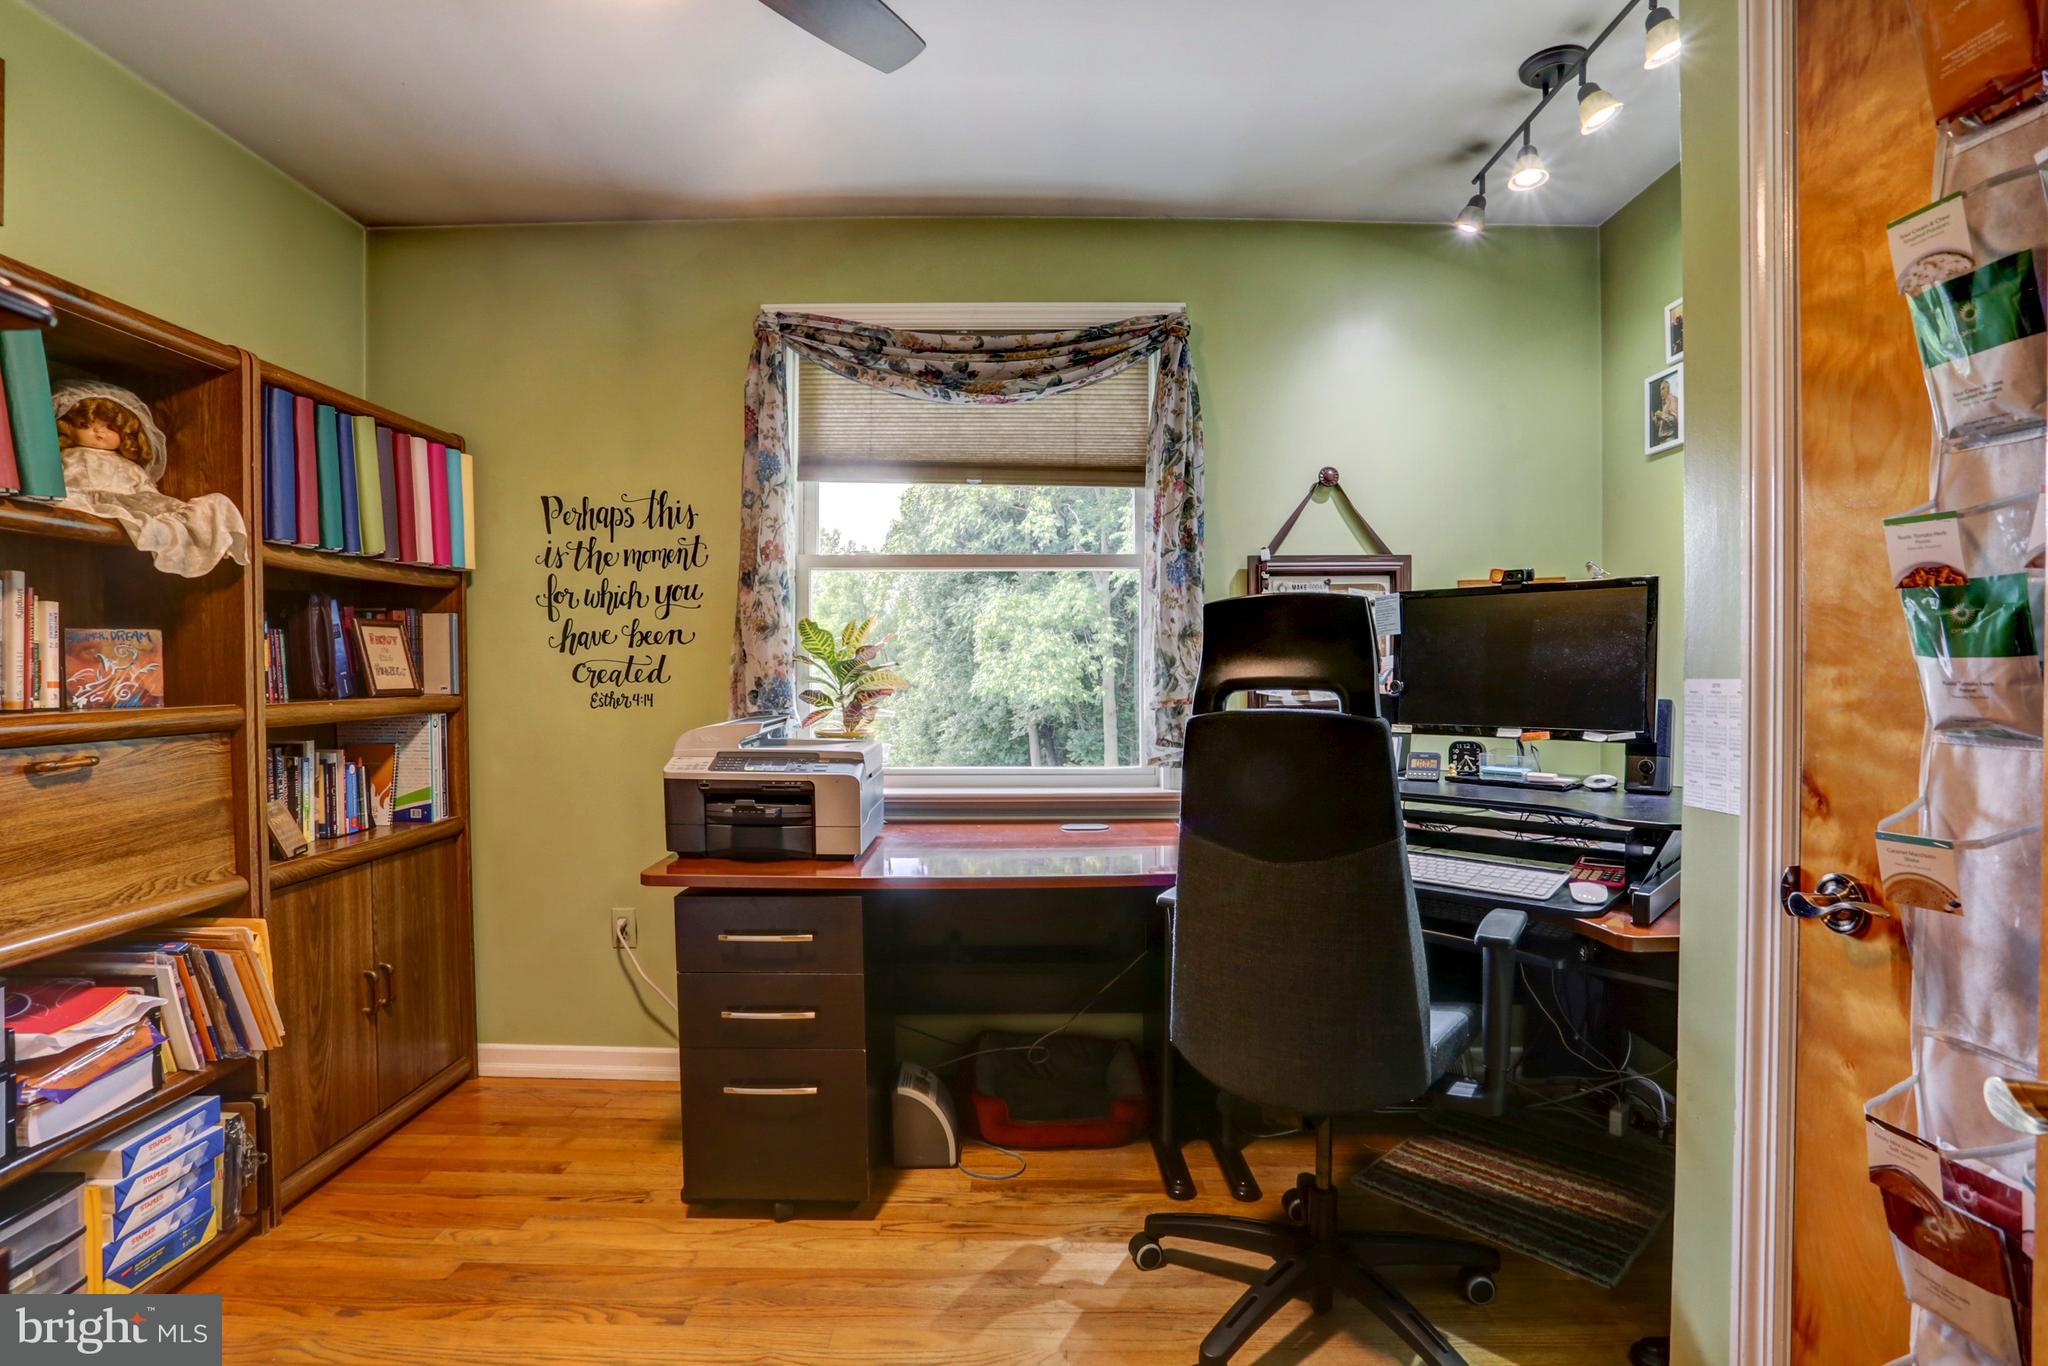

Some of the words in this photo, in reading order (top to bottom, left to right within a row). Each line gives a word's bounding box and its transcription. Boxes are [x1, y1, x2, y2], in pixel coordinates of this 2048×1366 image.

[541, 495, 635, 543] Perhaps
[621, 489, 699, 530] this
[535, 540, 569, 569] is
[566, 536, 620, 575] the
[624, 535, 709, 571] moment
[536, 573, 580, 623] for
[584, 577, 650, 615] which
[654, 583, 704, 620] you
[110, 629, 152, 645] DREAM
[548, 617, 618, 656] have
[621, 618, 696, 648] been
[590, 691, 632, 709] Esther
[632, 693, 654, 708] 4:14
[148, 1134, 173, 1150] STAPLES
[143, 1166, 169, 1184] STAPLES
[139, 1192, 165, 1211] STAPLES
[131, 1225, 156, 1245] STAPLES
